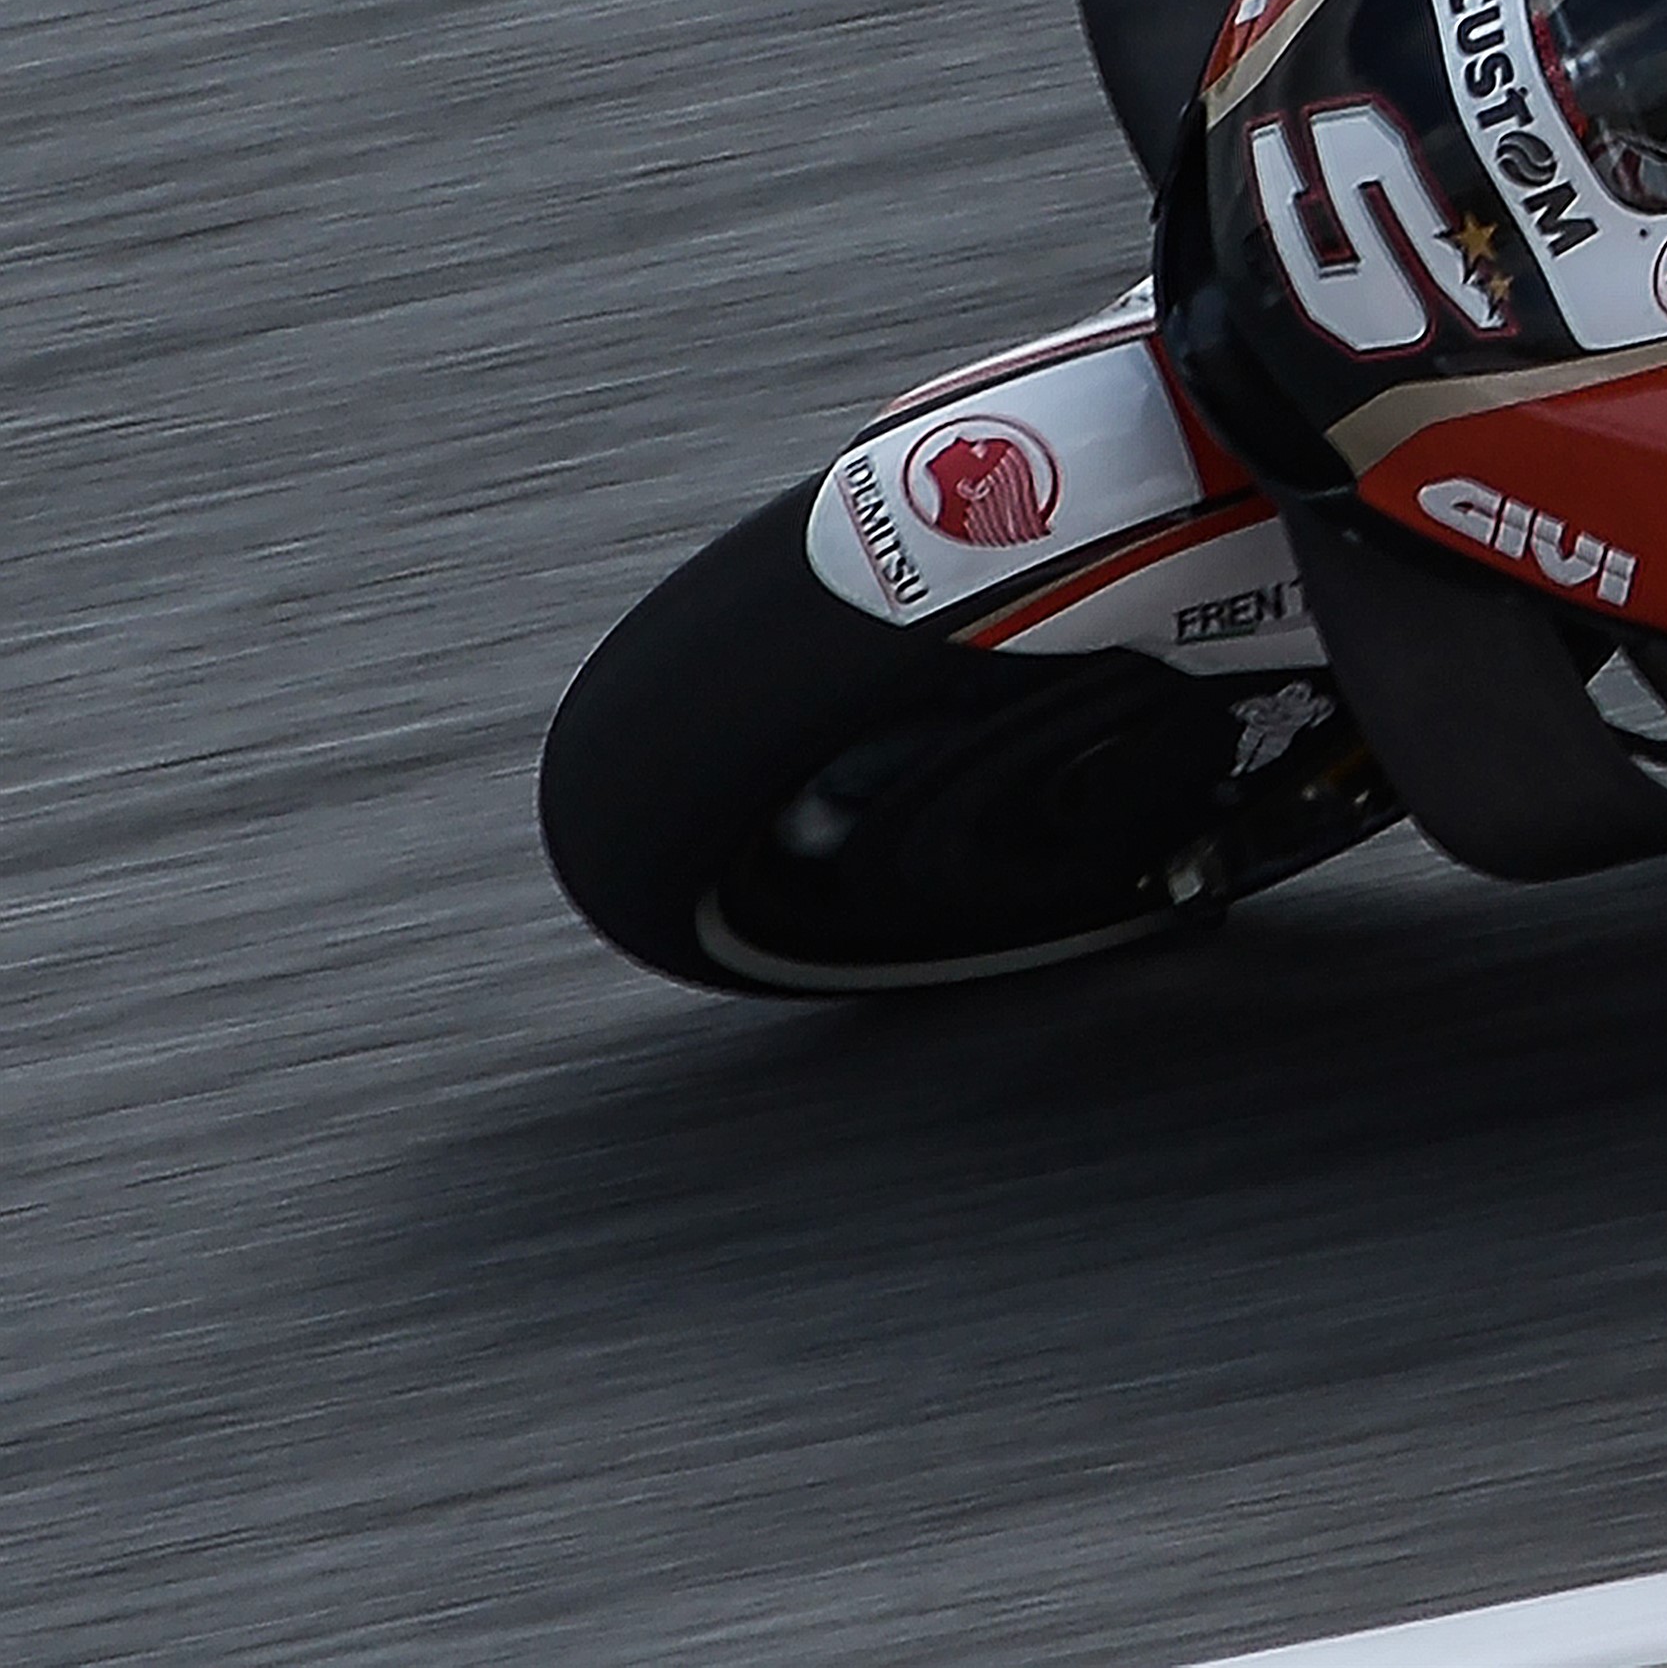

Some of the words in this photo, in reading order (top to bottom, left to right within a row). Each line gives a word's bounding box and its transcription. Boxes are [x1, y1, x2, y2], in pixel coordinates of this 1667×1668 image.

[1248, 96, 1512, 358] 5
[842, 454, 930, 607] IDEMITSU
[1418, 478, 1641, 607] GIVI
